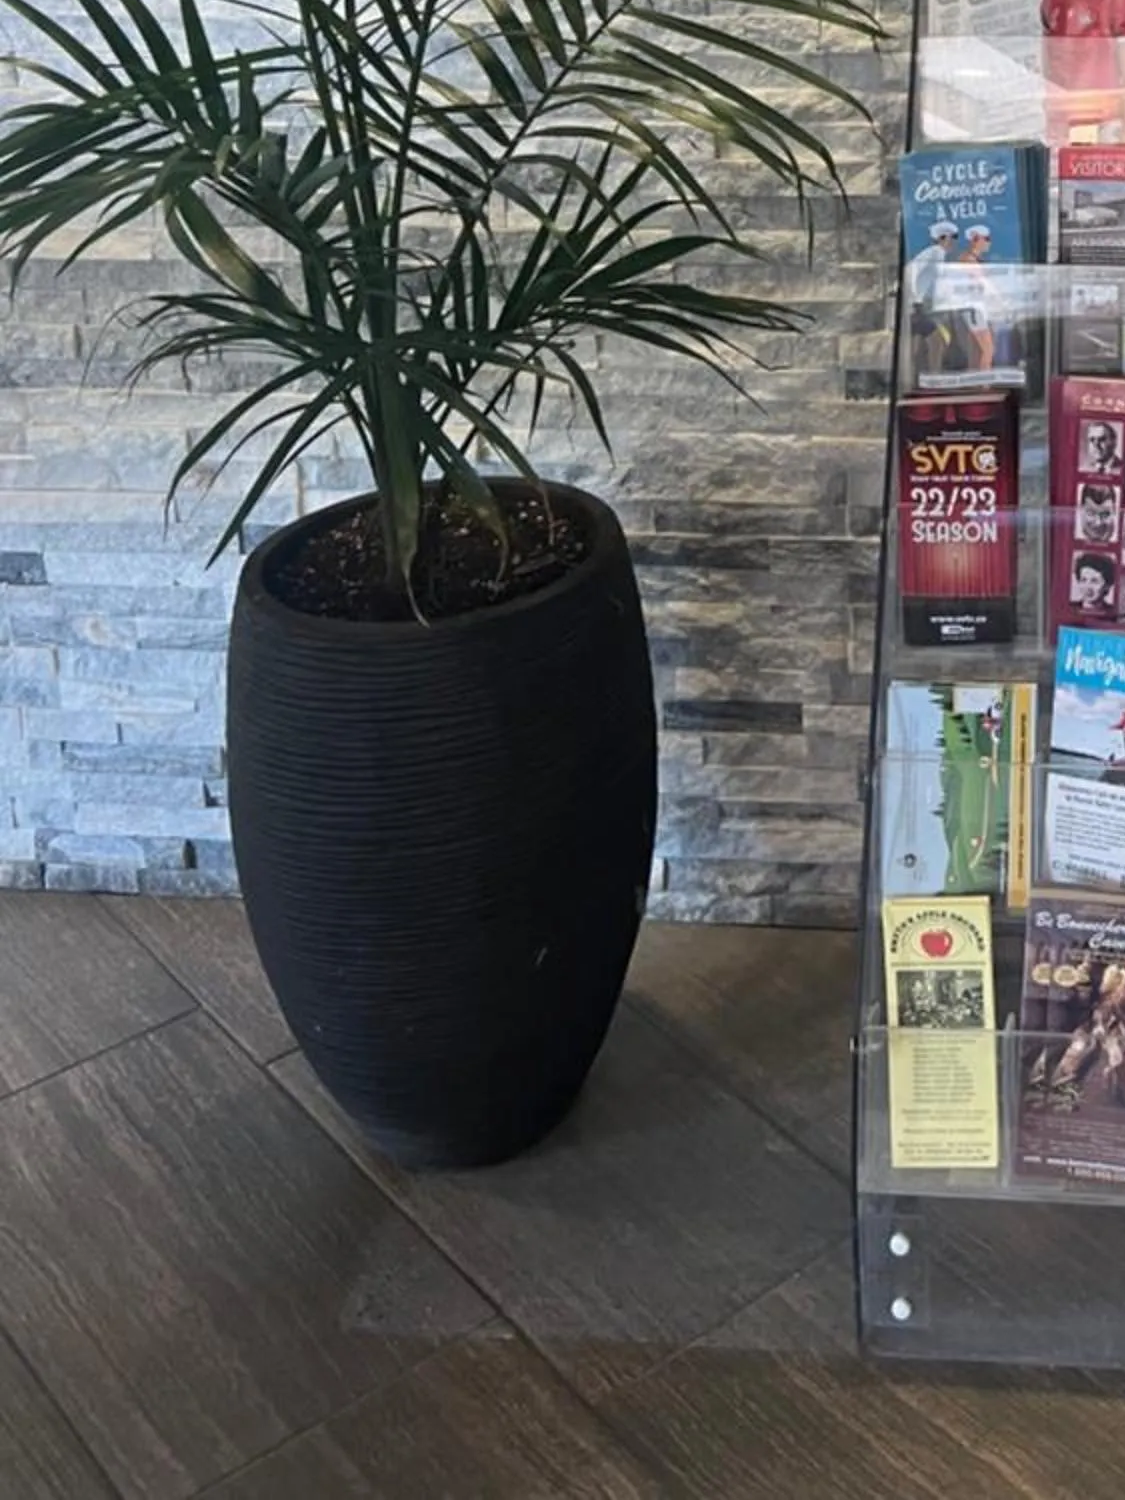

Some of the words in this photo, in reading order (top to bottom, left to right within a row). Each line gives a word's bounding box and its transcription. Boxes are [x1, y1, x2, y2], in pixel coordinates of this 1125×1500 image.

[931, 159, 989, 181] CYCLE
[909, 486, 998, 518] 22/23
[911, 520, 1000, 545] SEASON
